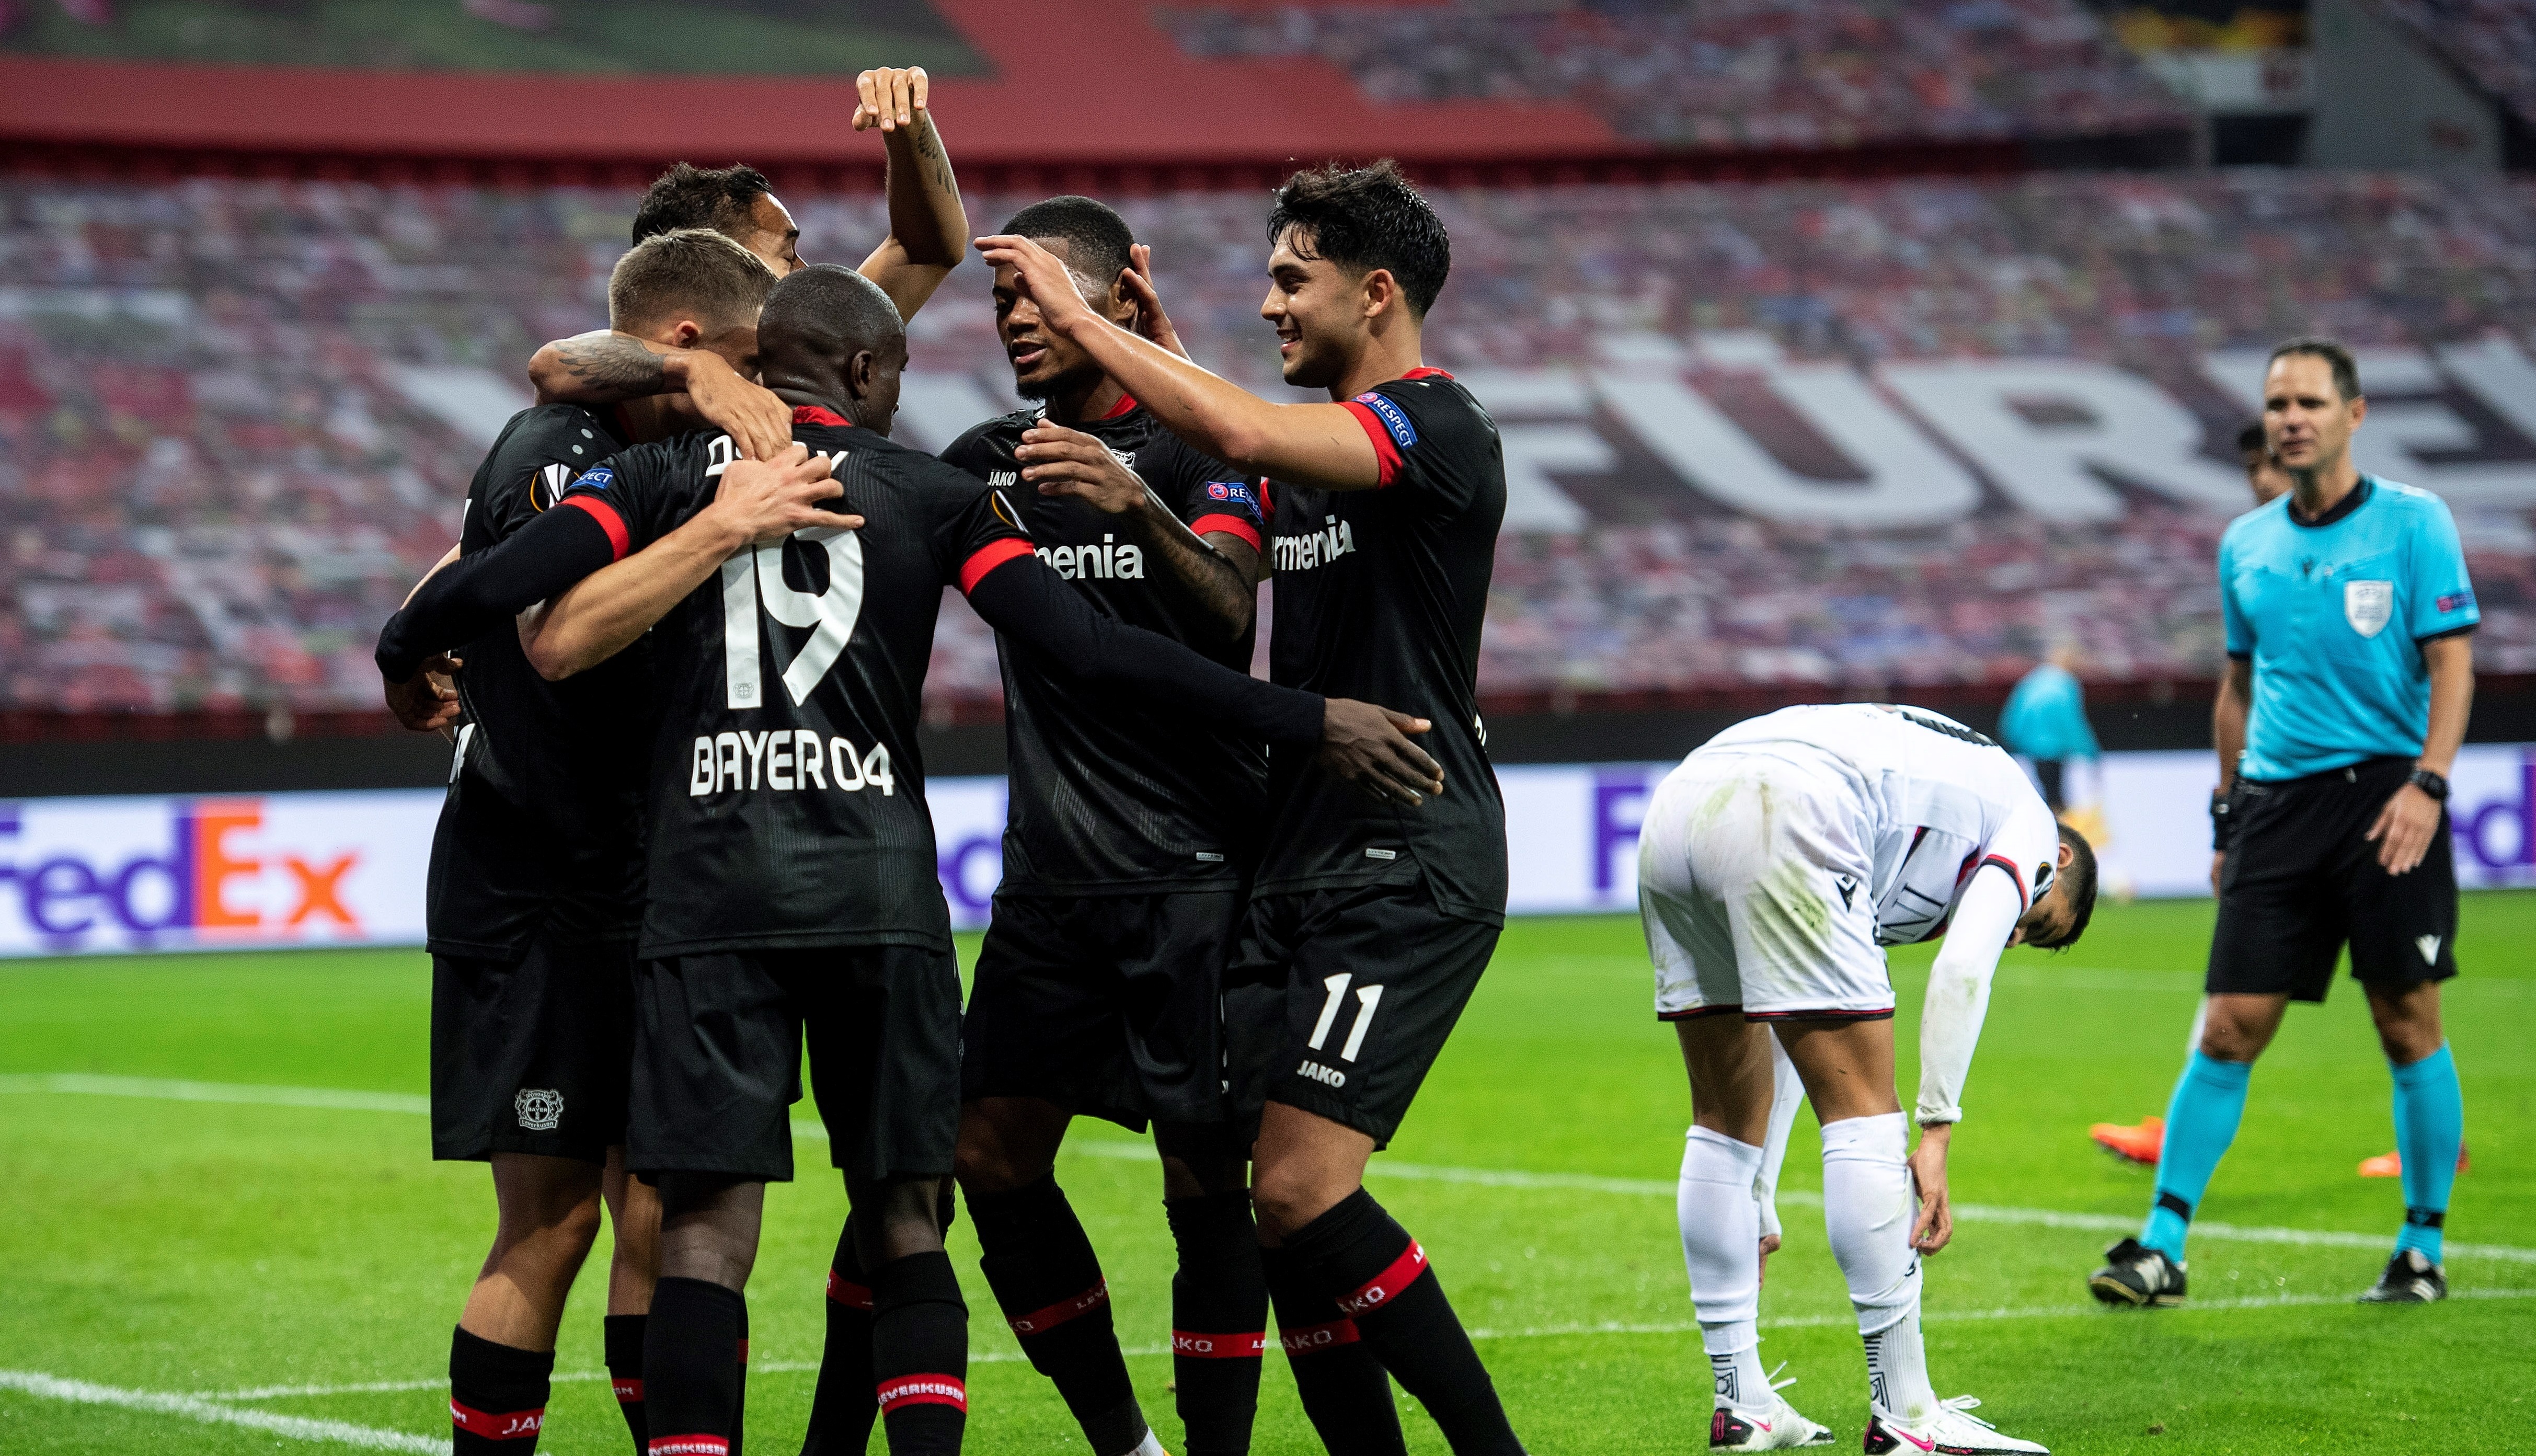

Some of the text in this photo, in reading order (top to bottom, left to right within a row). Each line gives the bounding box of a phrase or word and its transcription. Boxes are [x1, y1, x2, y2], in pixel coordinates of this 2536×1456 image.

[1374, 399, 1413, 446] RESPECT
[577, 472, 612, 483] SPECT
[987, 472, 1016, 486] JAKO
[1271, 515, 1356, 570] rmenia
[721, 526, 864, 709] 19
[690, 729, 894, 796] BAYER 04
[1308, 973, 1384, 1063] 11
[1296, 1060, 1346, 1088] JAKO
[1282, 1331, 1332, 1349] AKO
